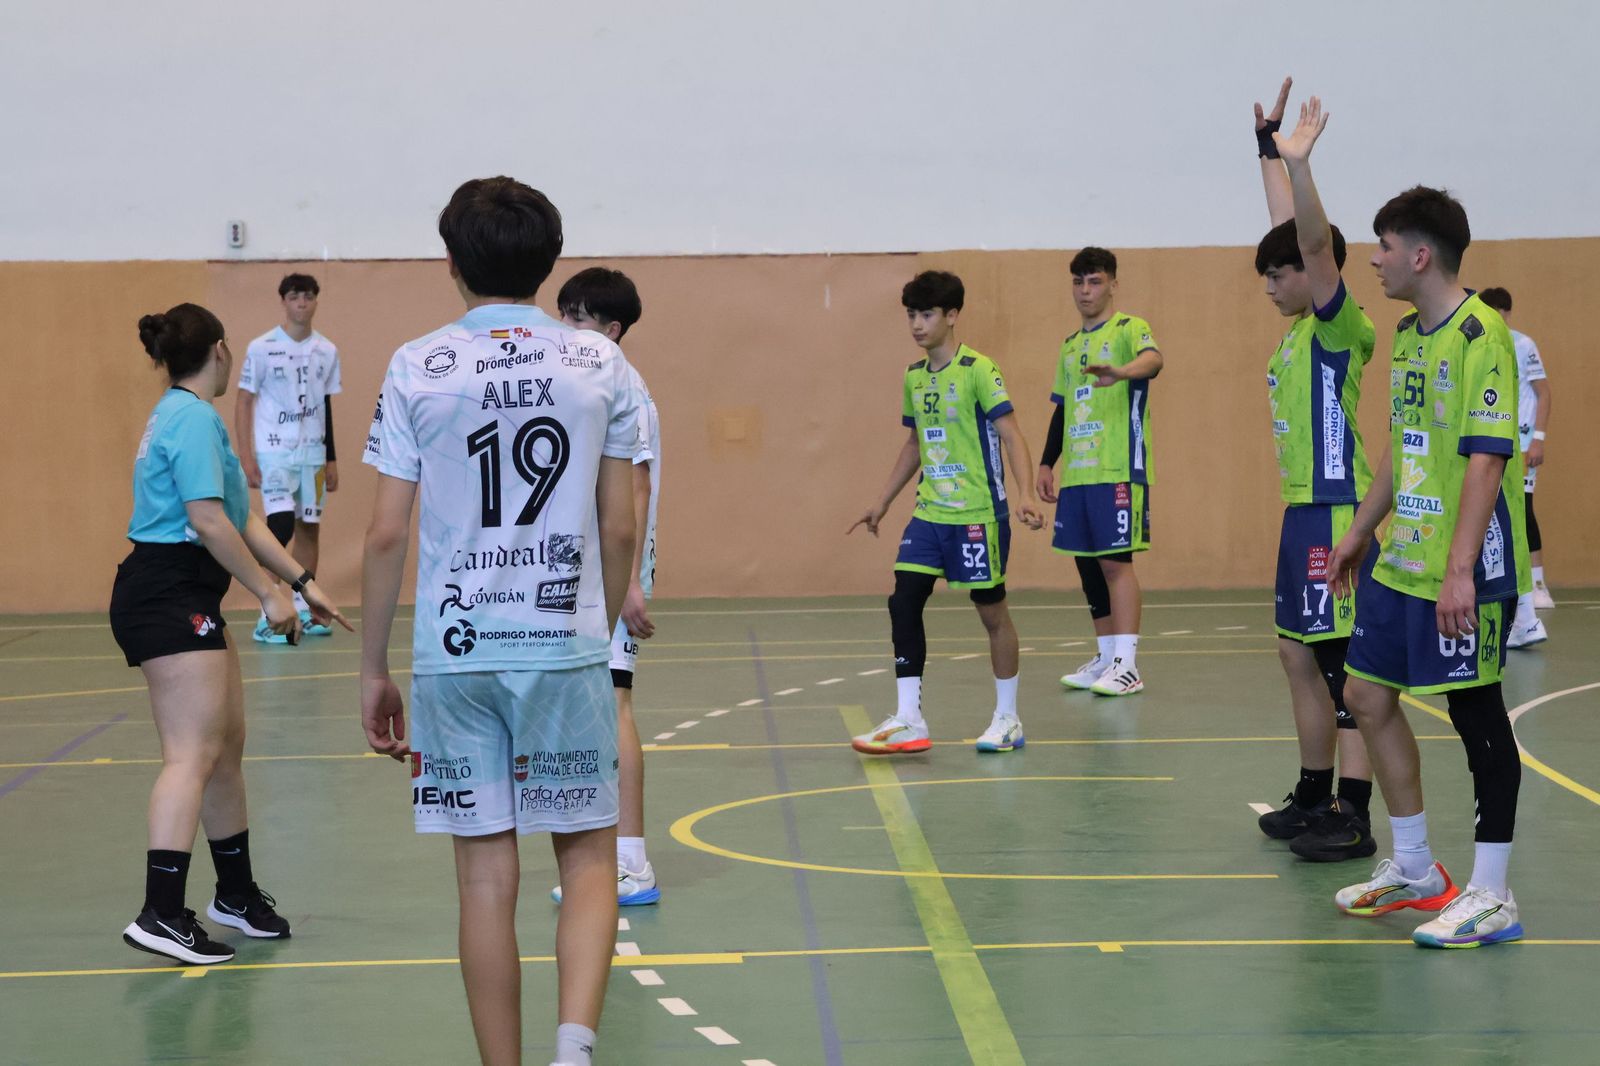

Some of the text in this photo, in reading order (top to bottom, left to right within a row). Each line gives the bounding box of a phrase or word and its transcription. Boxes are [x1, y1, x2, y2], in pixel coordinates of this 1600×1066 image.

[476, 349, 544, 375] Dromedario
[482, 378, 555, 410] ALEX
[1404, 371, 1426, 408] 63
[924, 393, 940, 415] 52
[1469, 410, 1511, 420] MORALEJO
[1331, 398, 1339, 450] PIORNO,
[1403, 433, 1424, 447] aza
[467, 416, 570, 528] 19
[1398, 494, 1442, 513] RURAL
[1117, 509, 1129, 534] 9
[962, 543, 987, 568] 52
[1302, 583, 1329, 616] 17
[480, 630, 526, 641] RODRIGO
[532, 750, 599, 764] AYUNTAMIENTO
[533, 762, 599, 776] VIANA DE CEGA
[520, 785, 553, 812] Rafa
